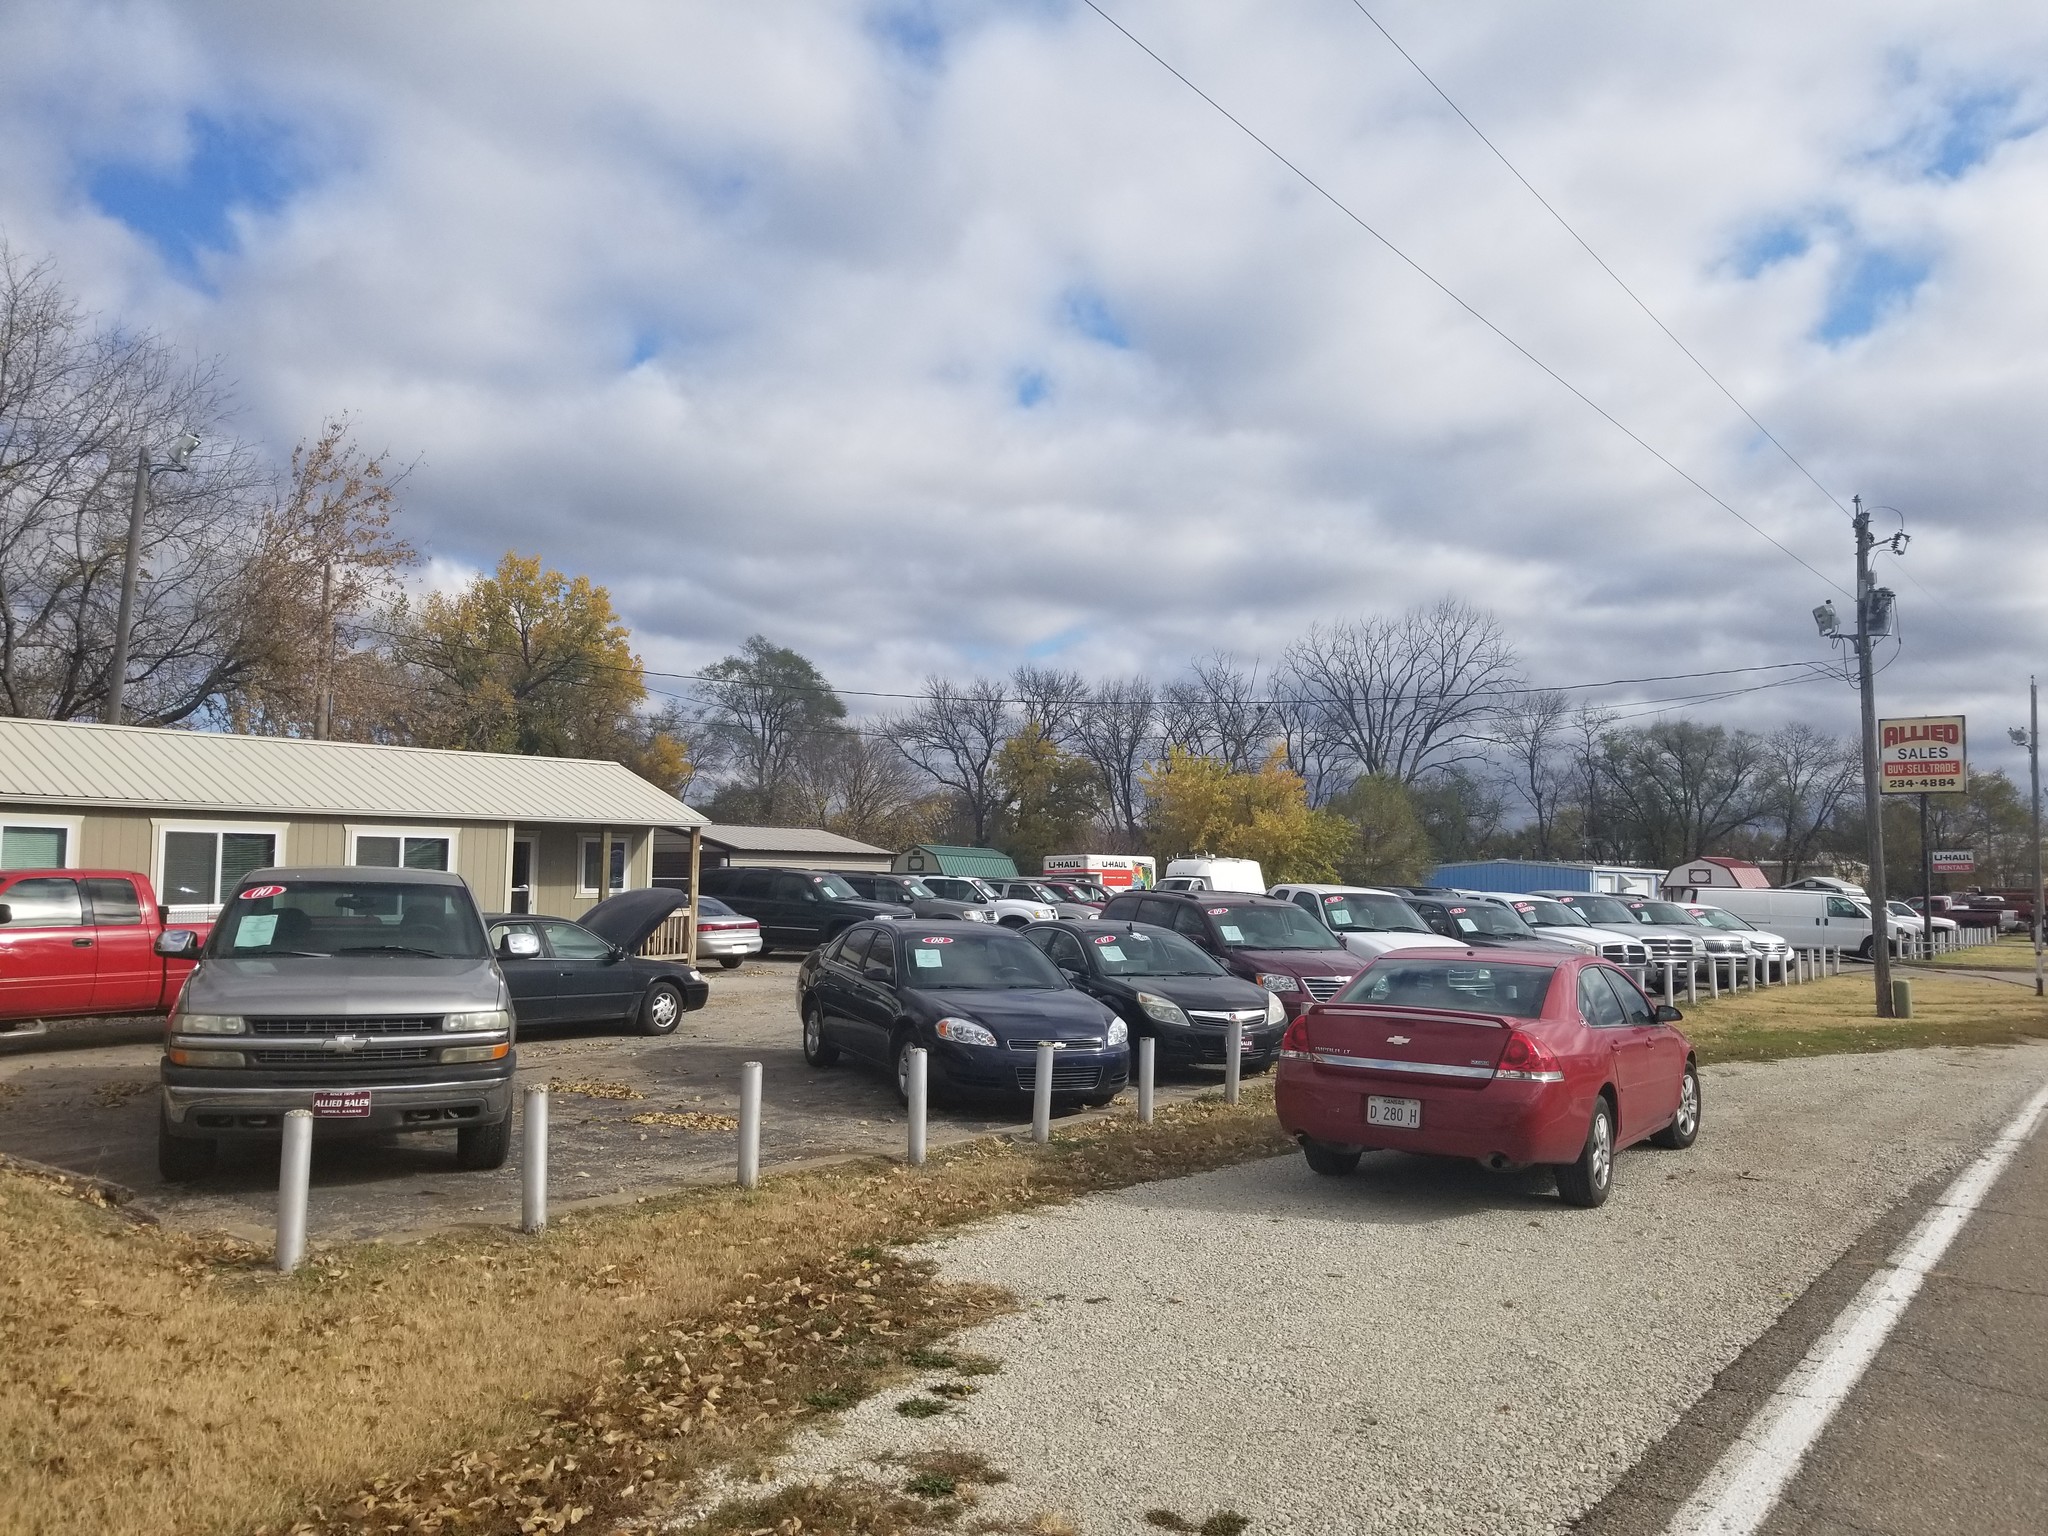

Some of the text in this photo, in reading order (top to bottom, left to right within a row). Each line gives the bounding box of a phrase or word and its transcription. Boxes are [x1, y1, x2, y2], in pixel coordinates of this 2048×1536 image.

[1884, 724, 1959, 749] ALLIED
[1898, 747, 1949, 760] SALES
[1048, 861, 1081, 869] U-HAUL
[1101, 861, 1128, 869] U-HAUL
[344, 1099, 369, 1107] SALES
[1370, 1105, 1417, 1123] D 280 H
